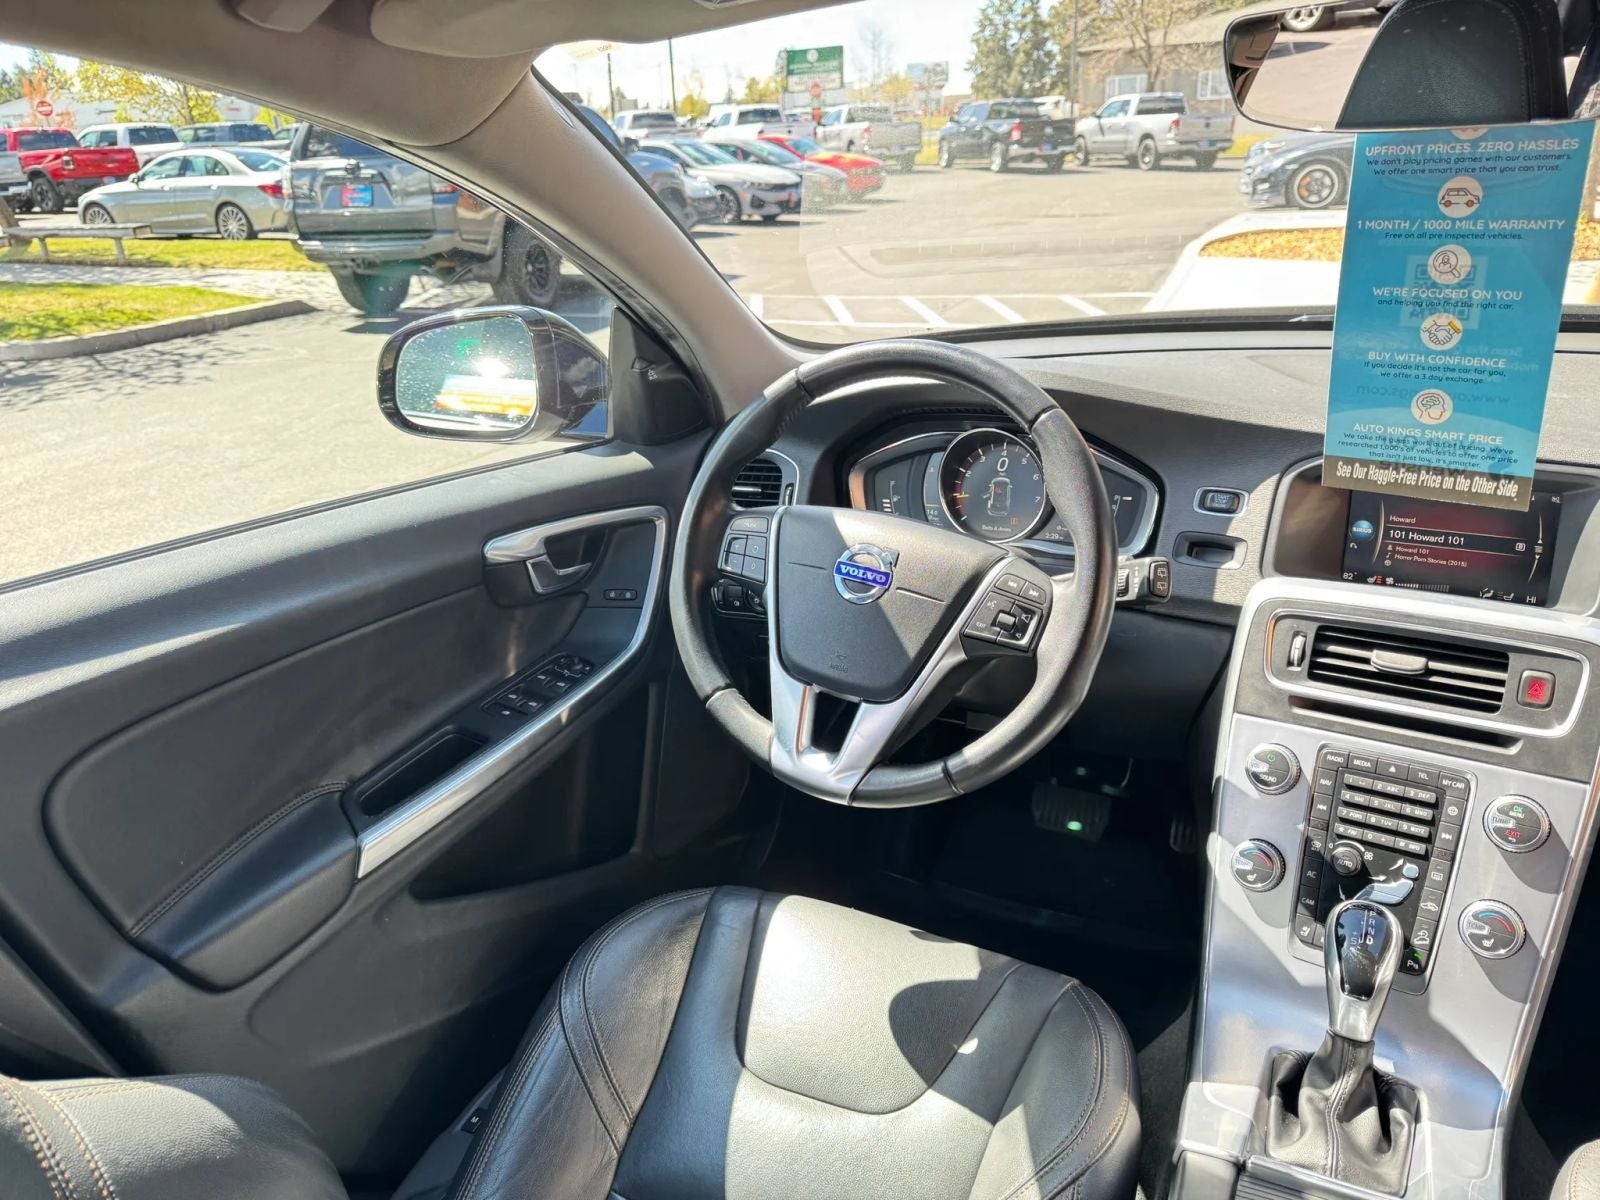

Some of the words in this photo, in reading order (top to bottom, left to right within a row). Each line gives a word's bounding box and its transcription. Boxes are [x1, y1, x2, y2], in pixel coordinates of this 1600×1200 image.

[1366, 145, 1424, 156] UPFRONT
[1478, 141, 1514, 152] ZERO
[1518, 139, 1579, 151] HASSLES
[1423, 157, 1451, 165] pricing
[1454, 156, 1482, 165] games
[1455, 166, 1476, 174] price
[1365, 220, 1410, 229] MONTH
[1412, 219, 1420, 230] /
[1424, 220, 1452, 229] 1000
[1455, 220, 1485, 230] MILE
[1488, 220, 1565, 229] WARRANTY
[1444, 232, 1486, 240] inspected
[1373, 287, 1409, 296] WE'RE
[1411, 288, 1468, 298] FOCUSED
[1472, 290, 1491, 299] ON
[1496, 290, 1522, 300] YOU
[1394, 299, 1423, 307] helping
[1368, 352, 1391, 360] BUY
[1394, 353, 1425, 362] WITH
[1428, 354, 1507, 368] CONFIDENCE
[1428, 374, 1443, 382] day
[1353, 424, 1384, 433] AUTO
[1387, 426, 1421, 436] KINGS
[1424, 429, 1465, 441] SMART
[1469, 434, 1504, 445] PRICE
[1338, 441, 1378, 449] researched
[1416, 448, 1446, 456] vehicles
[997, 457, 1008, 471] 0
[1337, 461, 1351, 478] See
[1353, 463, 1367, 479] Our
[1368, 464, 1418, 485] Haggle-Free
[1418, 470, 1442, 488] Price
[1443, 477, 1454, 489] on
[1455, 475, 1471, 491] the
[1472, 476, 1497, 495] Other
[1390, 515, 1416, 524] Howard
[1389, 530, 1406, 539] 101
[1409, 533, 1444, 543] Howard
[1448, 536, 1465, 545] 101
[840, 563, 886, 582] VOLVO
[1327, 755, 1344, 763] RADIO
[1354, 759, 1371, 768] MEDIA
[1260, 773, 1277, 782] SOUND
[1513, 805, 1523, 813] OK
[1505, 829, 1521, 839] EXIT
[1307, 870, 1317, 878] AC
[1301, 898, 1315, 906] CAM
[1368, 927, 1375, 935] N
[1366, 935, 1374, 944] D
